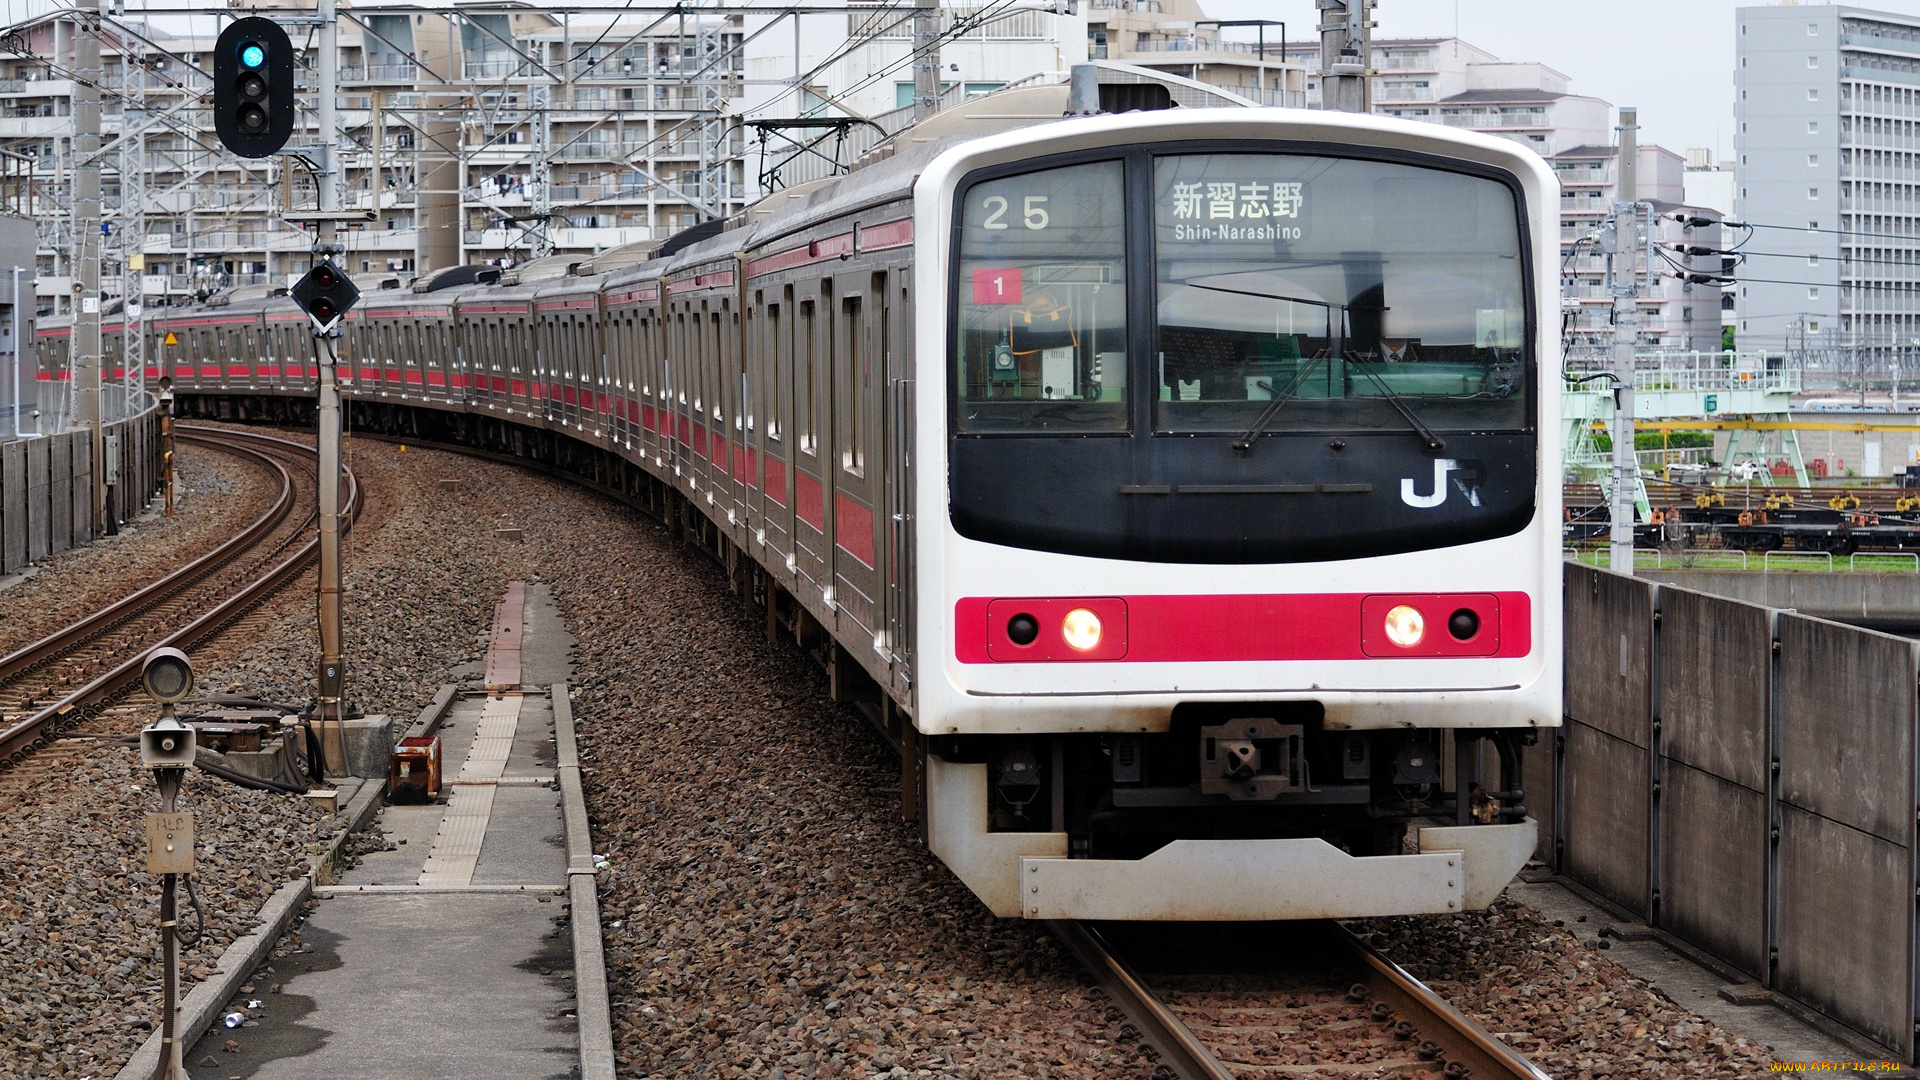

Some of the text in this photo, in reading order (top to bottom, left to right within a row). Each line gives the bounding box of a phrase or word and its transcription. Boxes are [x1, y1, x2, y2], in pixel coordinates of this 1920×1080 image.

[983, 195, 1050, 230] 25
[1172, 181, 1304, 220] 新習志野
[1174, 224, 1302, 240] Shin-Narashino
[993, 276, 1004, 296] 1
